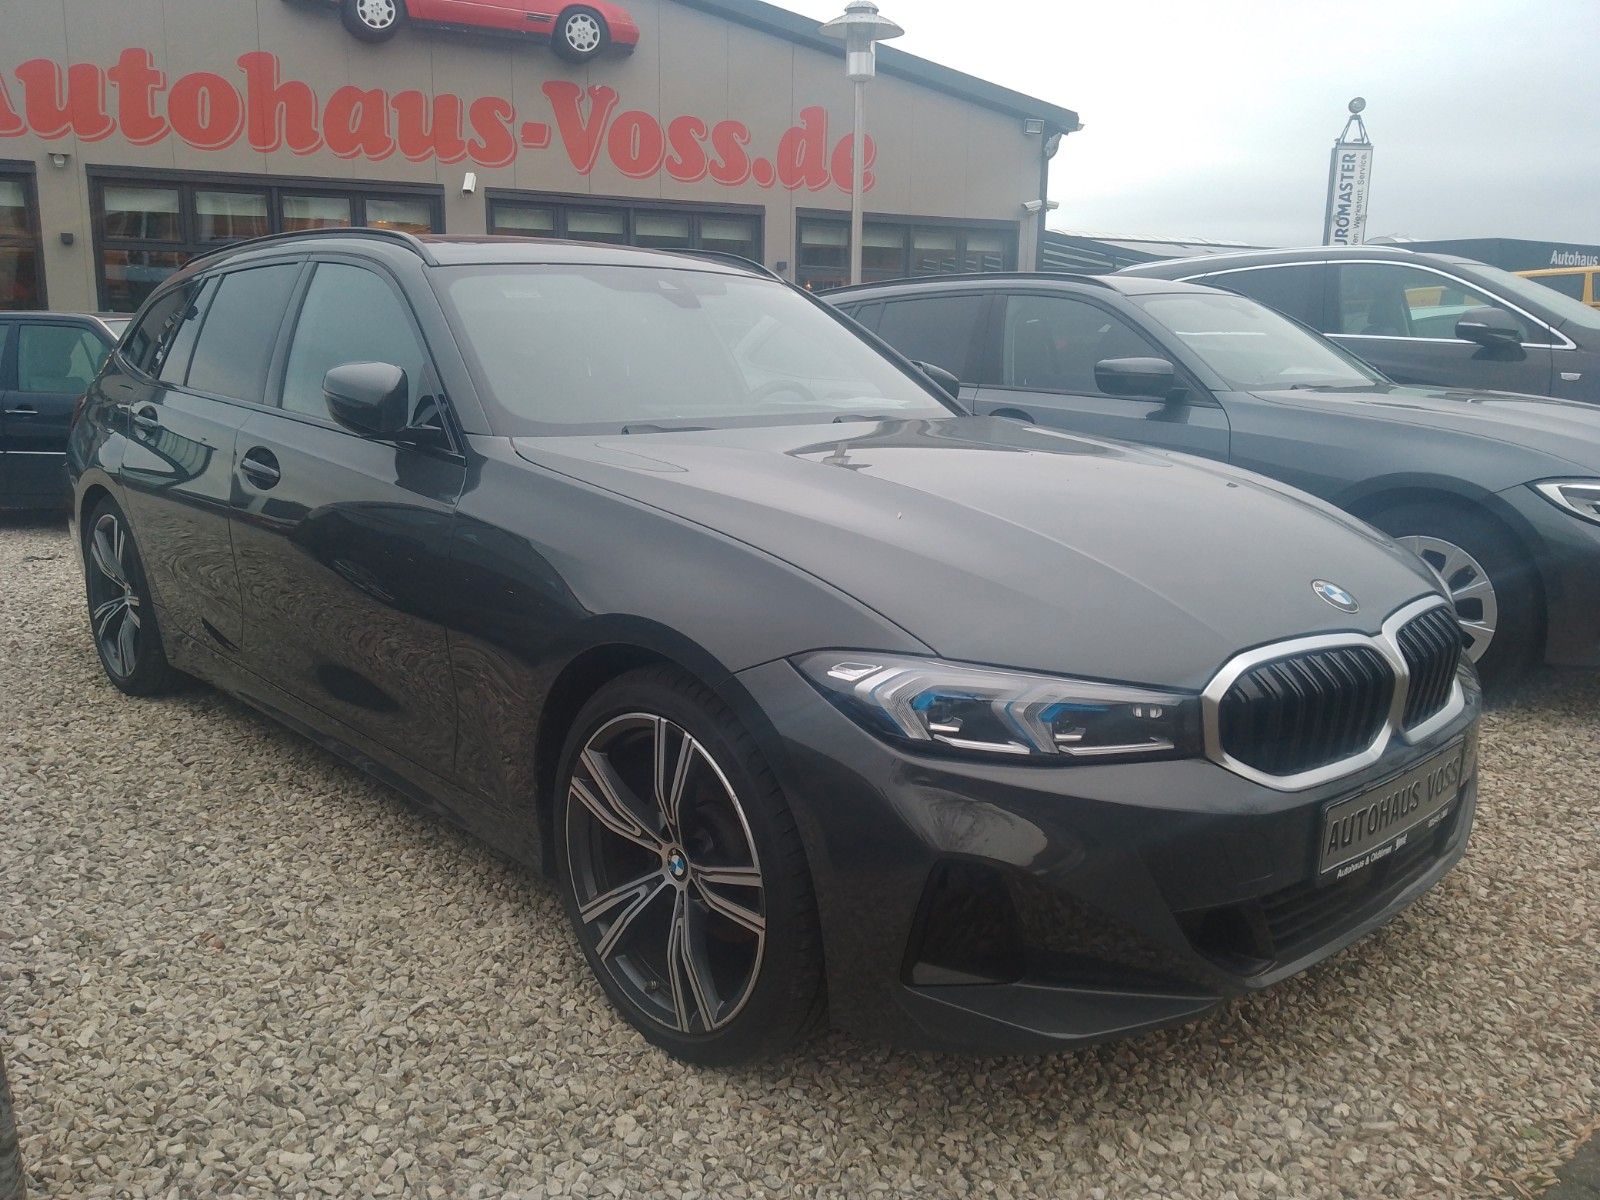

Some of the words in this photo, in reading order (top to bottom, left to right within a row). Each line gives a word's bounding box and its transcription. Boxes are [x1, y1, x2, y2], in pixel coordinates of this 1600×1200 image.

[0, 47, 877, 194] utohaus-Voss.de
[1550, 250, 1599, 266] Autohaus
[1327, 781, 1421, 855] AUTOHAUS
[1427, 757, 1461, 801] VOSS
